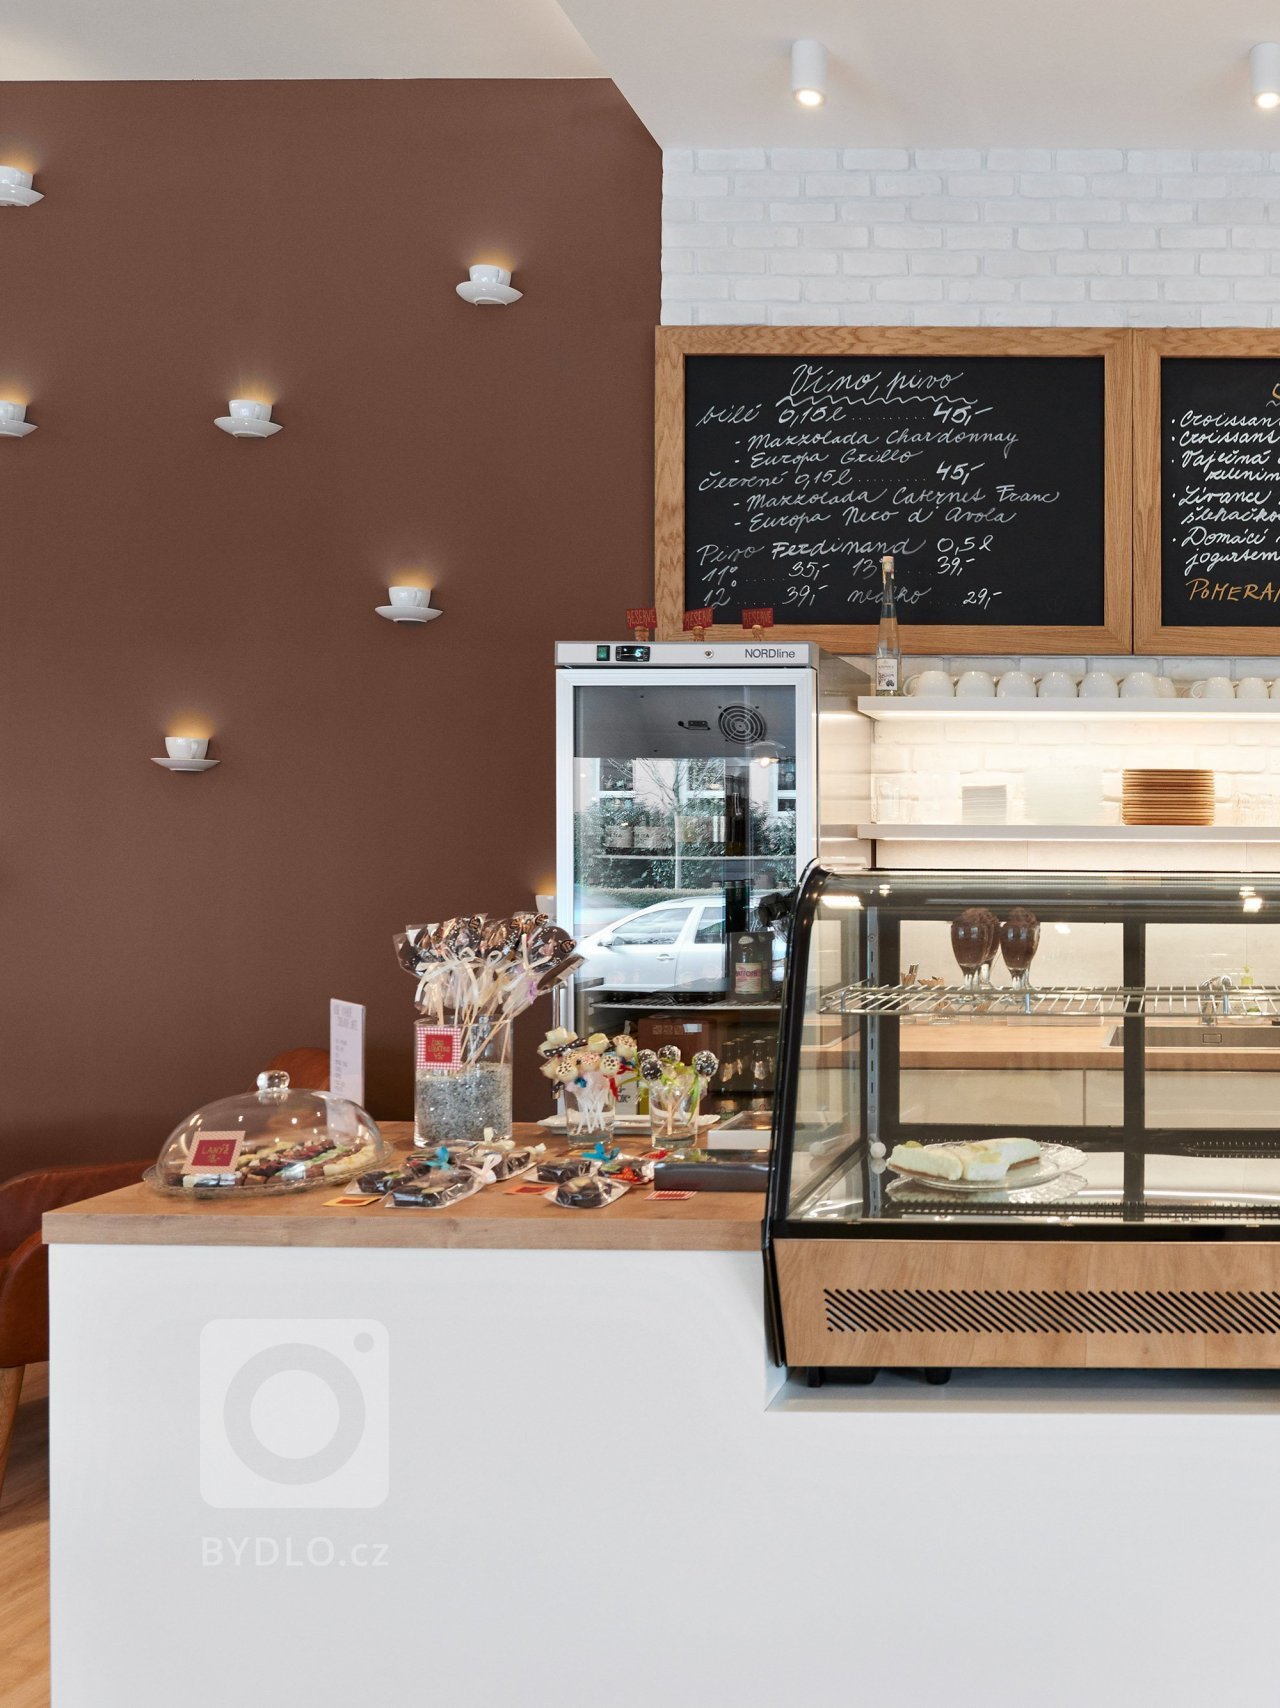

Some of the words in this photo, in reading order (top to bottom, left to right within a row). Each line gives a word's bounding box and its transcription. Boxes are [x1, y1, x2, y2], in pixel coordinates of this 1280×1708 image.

[886, 369, 964, 399] pivo
[747, 430, 880, 451] Mazzolada
[885, 427, 1019, 460] Chardonnay
[1179, 429, 1280, 447] Croissant
[750, 451, 830, 474] Europa
[840, 448, 924, 465] Grillo
[746, 488, 888, 512] Mazzolada
[995, 484, 1061, 503] Franc
[749, 512, 831, 533] Europa
[1181, 526, 1269, 547] Domácí
[697, 544, 766, 566] Pivo
[772, 537, 926, 560] Ferdinand
[745, 648, 796, 659] NORDline
